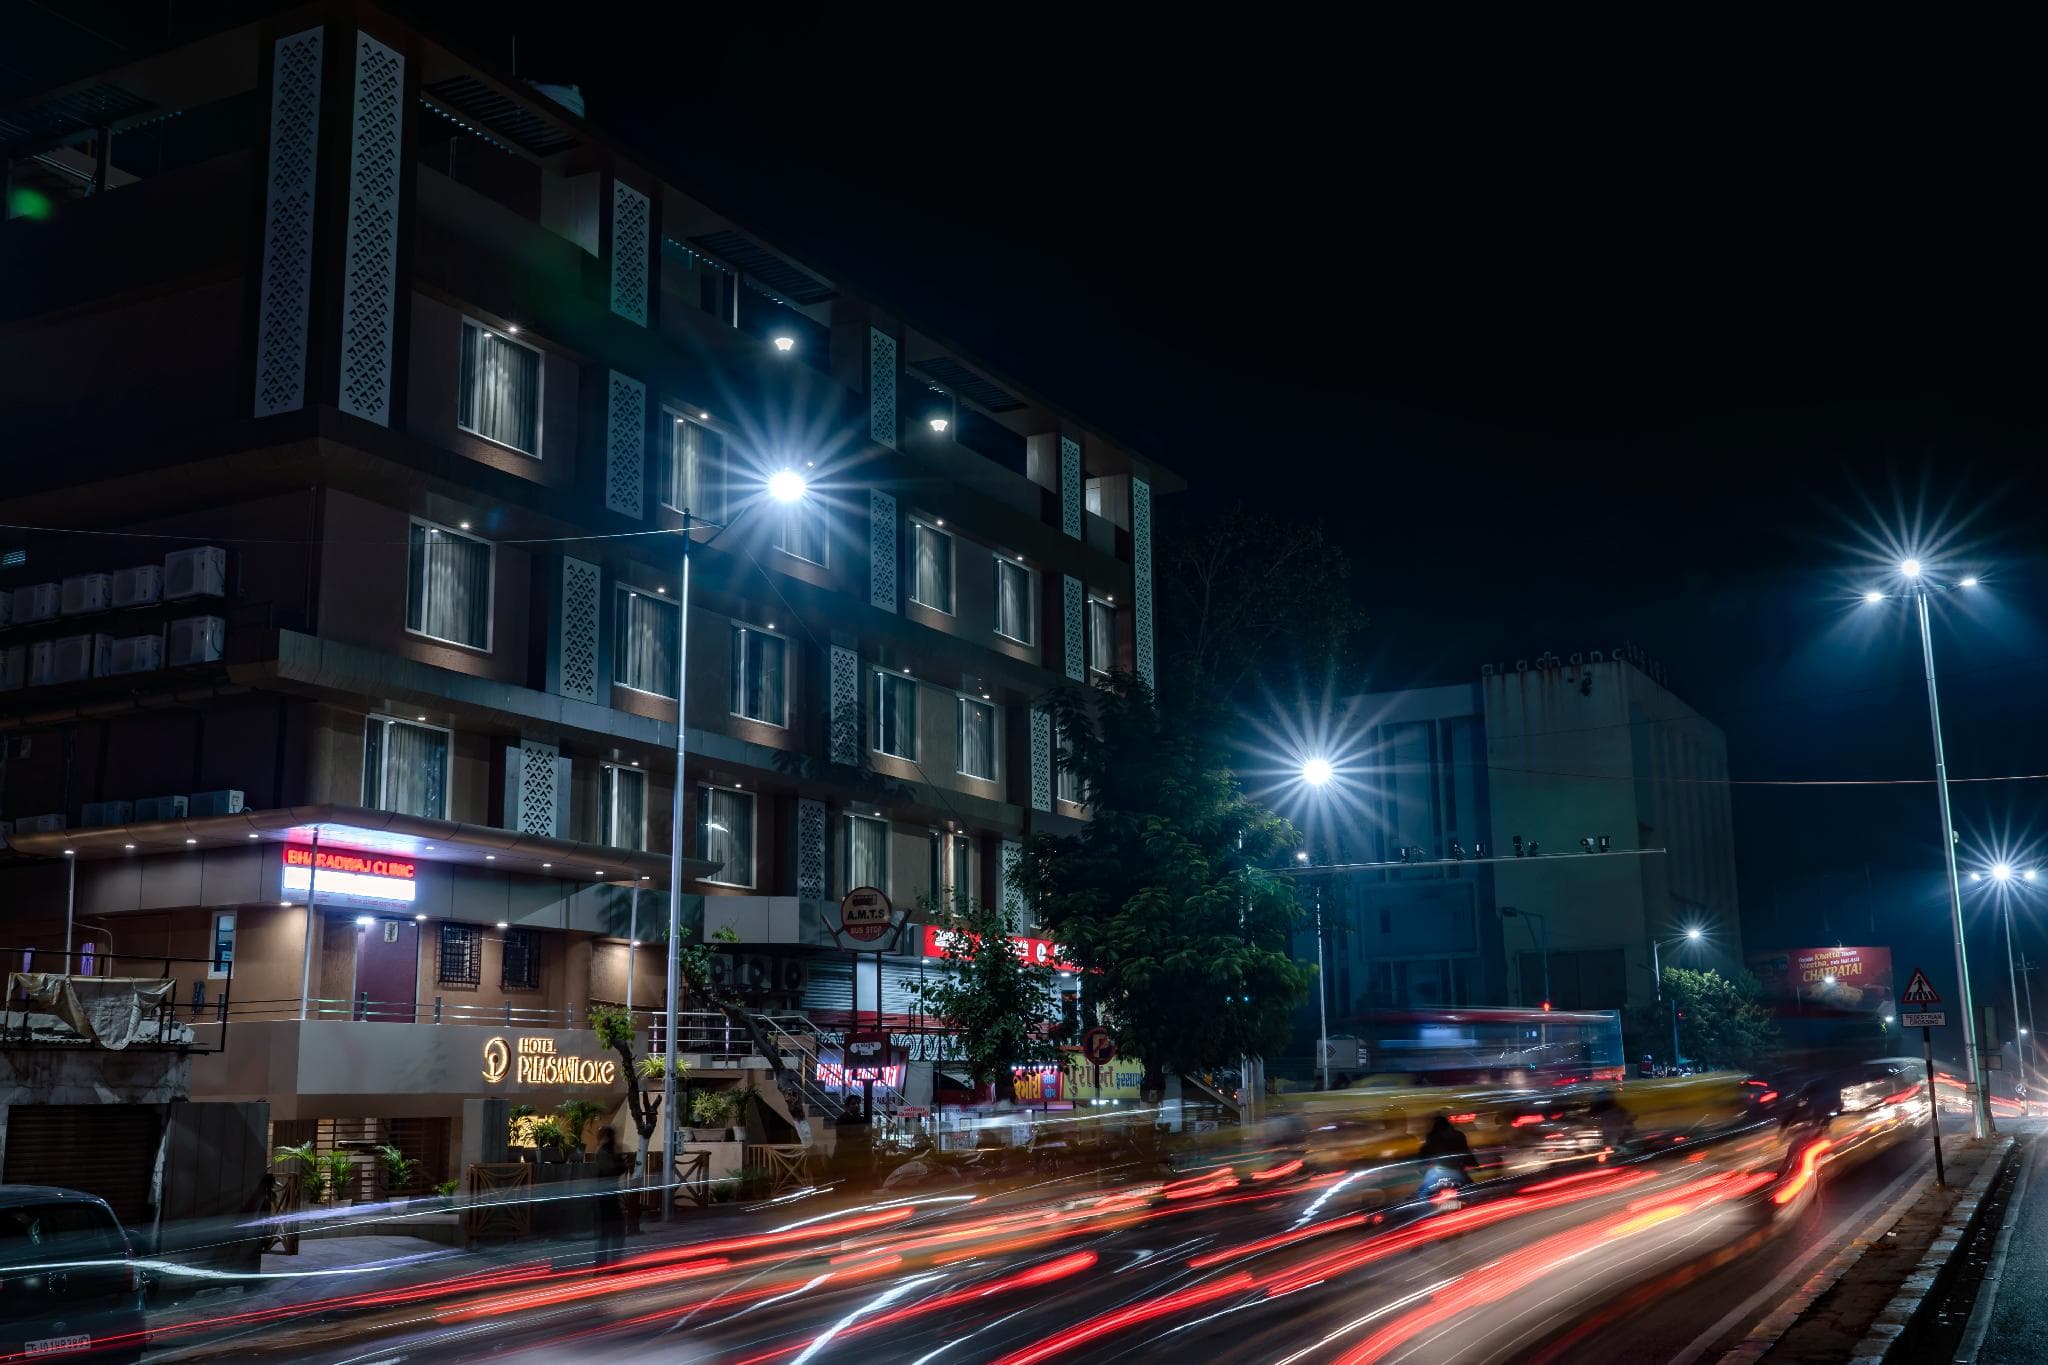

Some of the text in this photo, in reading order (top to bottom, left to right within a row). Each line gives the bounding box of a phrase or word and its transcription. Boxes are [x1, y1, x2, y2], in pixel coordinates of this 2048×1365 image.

[373, 860, 414, 879] CLINIC
[1803, 962, 1862, 982] CHATPATA!
[518, 1037, 557, 1054] HOTEL
